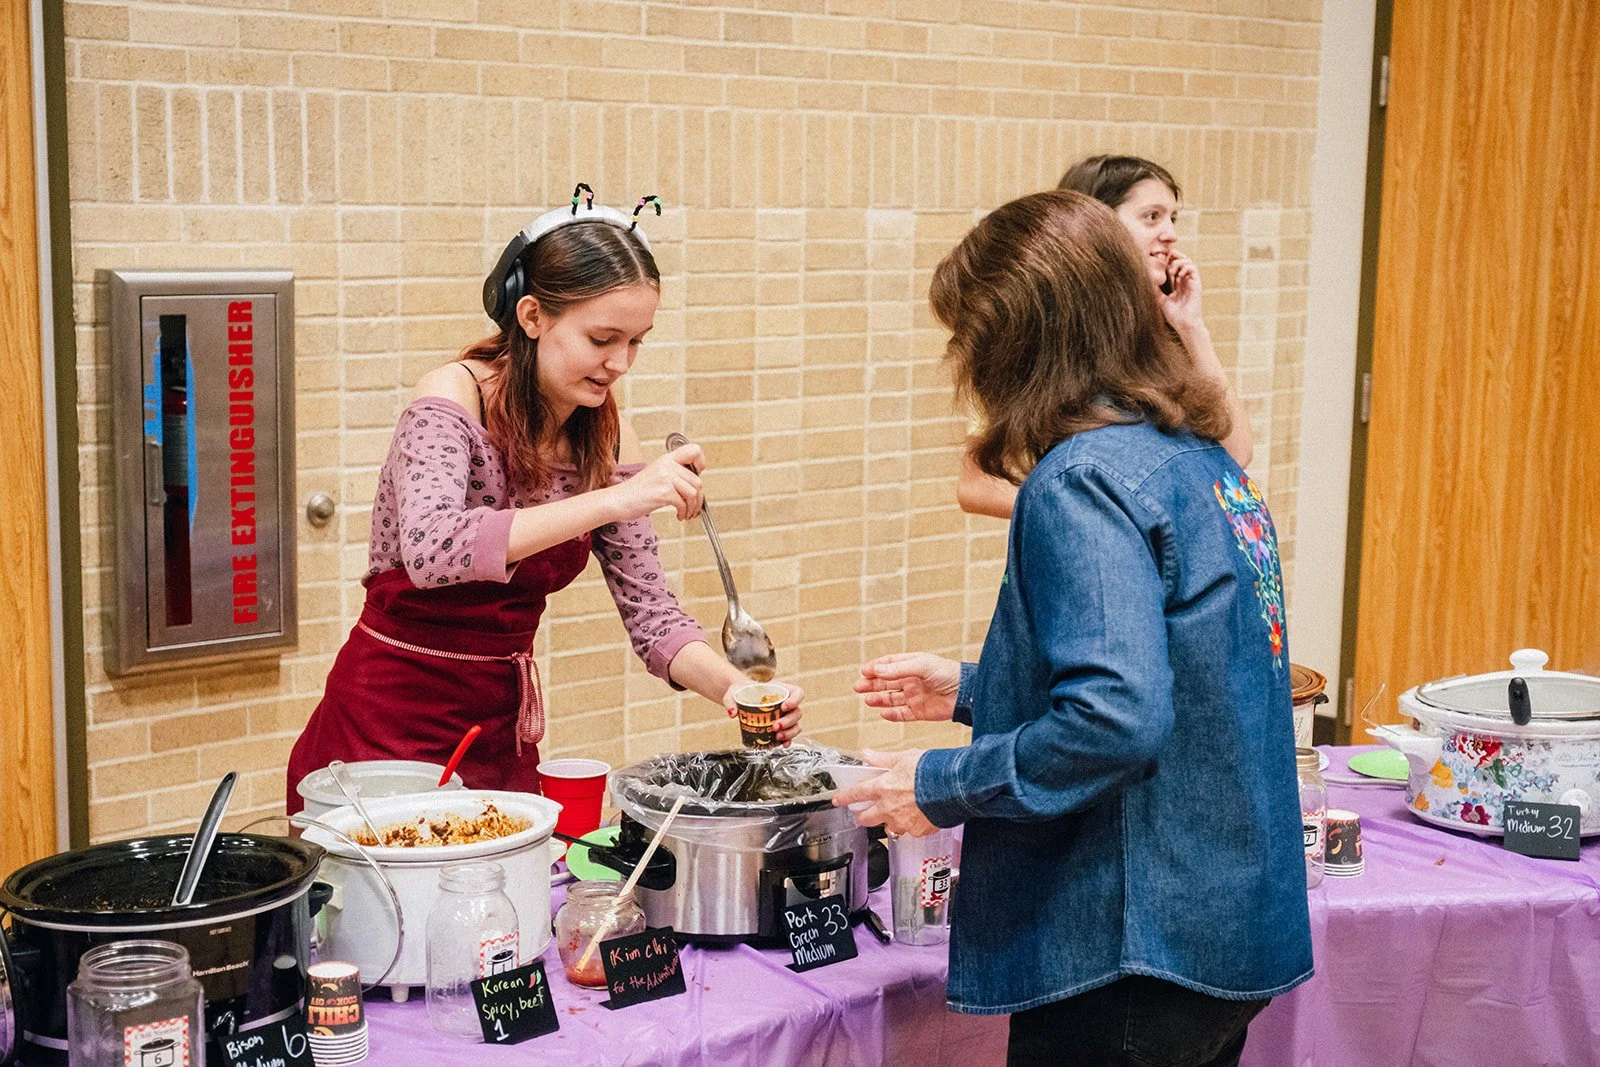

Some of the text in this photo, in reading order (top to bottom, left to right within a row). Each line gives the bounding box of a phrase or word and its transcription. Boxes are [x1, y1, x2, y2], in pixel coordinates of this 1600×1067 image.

[227, 300, 258, 625] FIRE EXTINGUISHER
[1507, 805, 1539, 818] Turkey
[1507, 815, 1574, 840] Medium 32
[1305, 834, 1312, 843] 7
[939, 878, 948, 889] 33
[784, 904, 848, 935] Pork 33
[789, 928, 820, 949] Green
[610, 946, 641, 968] Kim
[794, 942, 836, 965] Medium
[192, 960, 250, 977] Hamilton Beach
[481, 978, 525, 998] Korean
[629, 975, 647, 988] the
[336, 995, 358, 1006] COOK
[518, 986, 544, 1010] beef
[307, 1003, 360, 1026] CHILI
[494, 1018, 510, 1041] 1
[226, 1024, 307, 1060] Bison 6
[154, 1053, 162, 1065] 6
